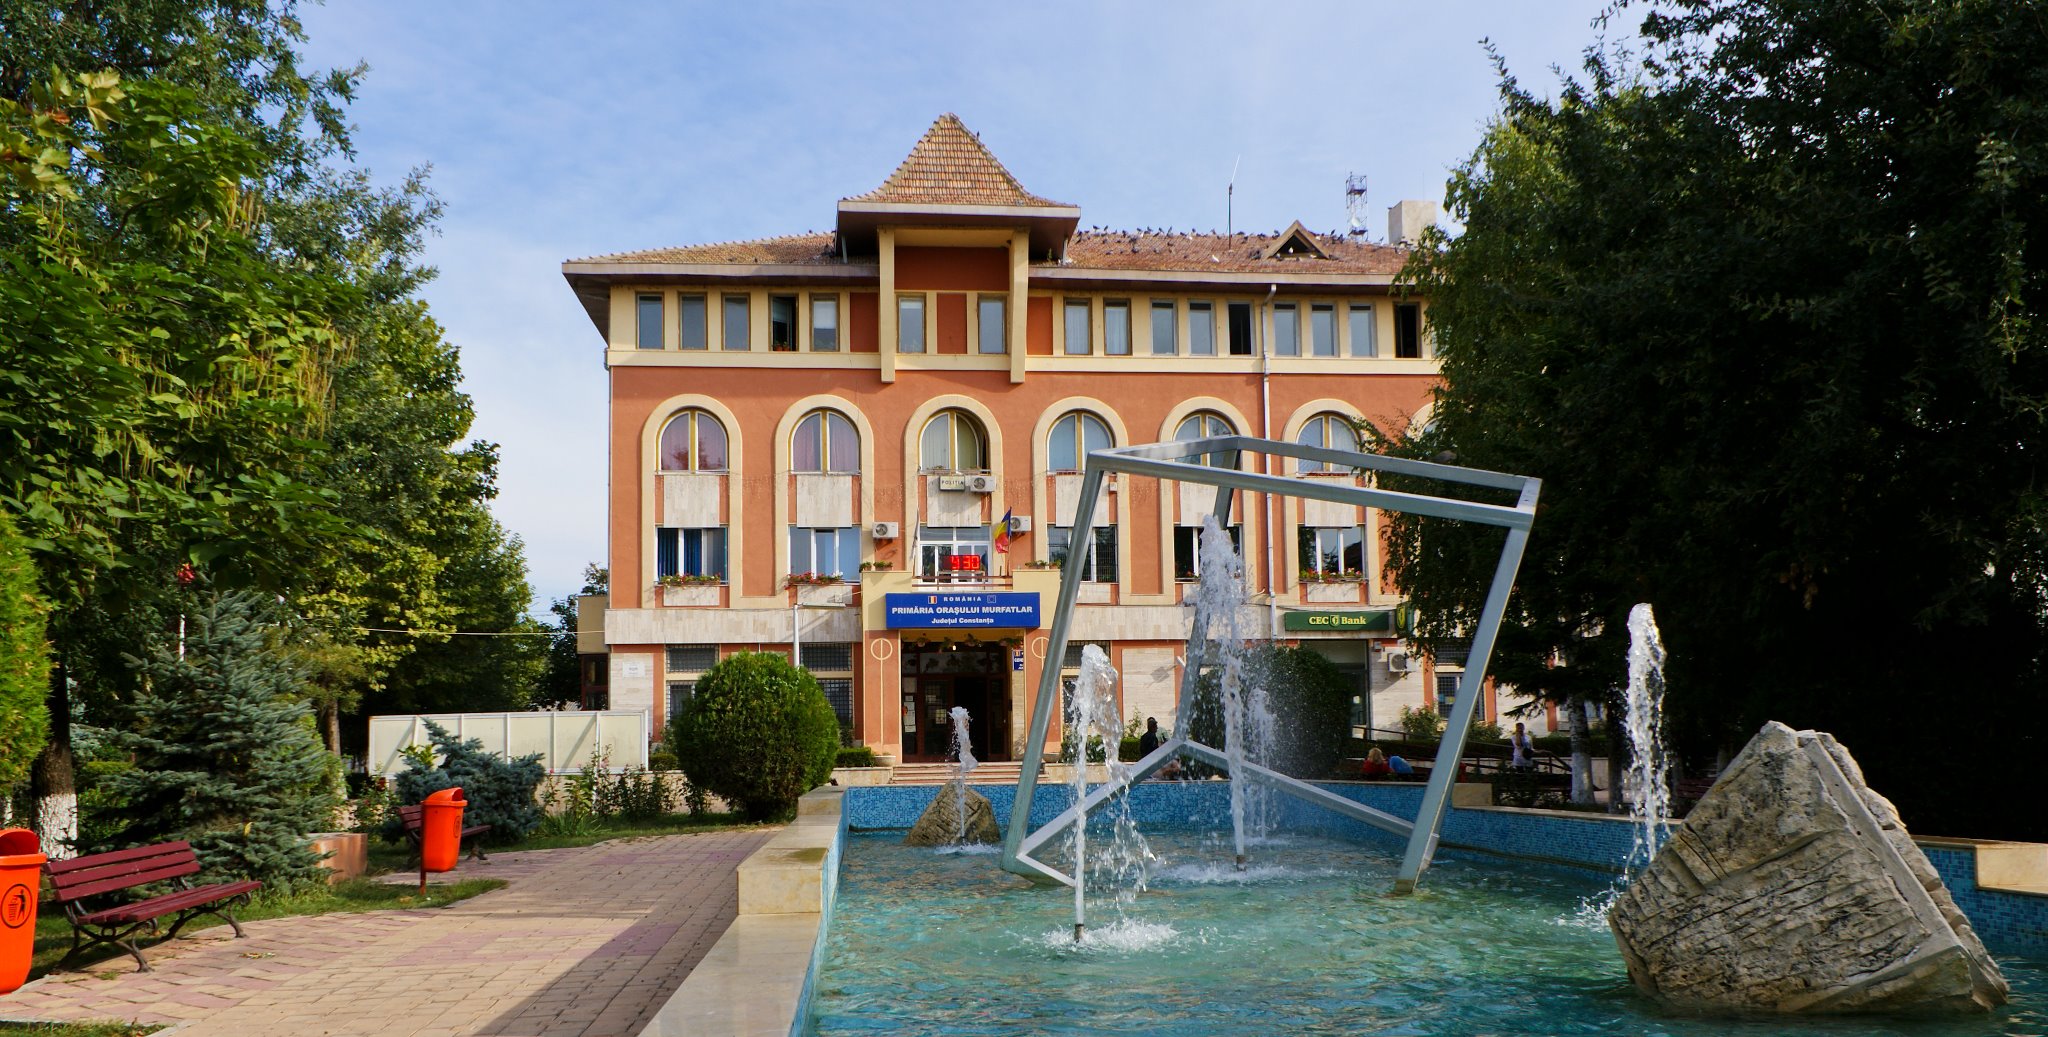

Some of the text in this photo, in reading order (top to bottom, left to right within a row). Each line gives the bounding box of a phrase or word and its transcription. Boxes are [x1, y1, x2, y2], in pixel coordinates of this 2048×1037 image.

[891, 605, 934, 615] PRIMĂRIA
[981, 606, 1033, 614] MURFATLAR
[1309, 616, 1366, 625] CEC Bank
